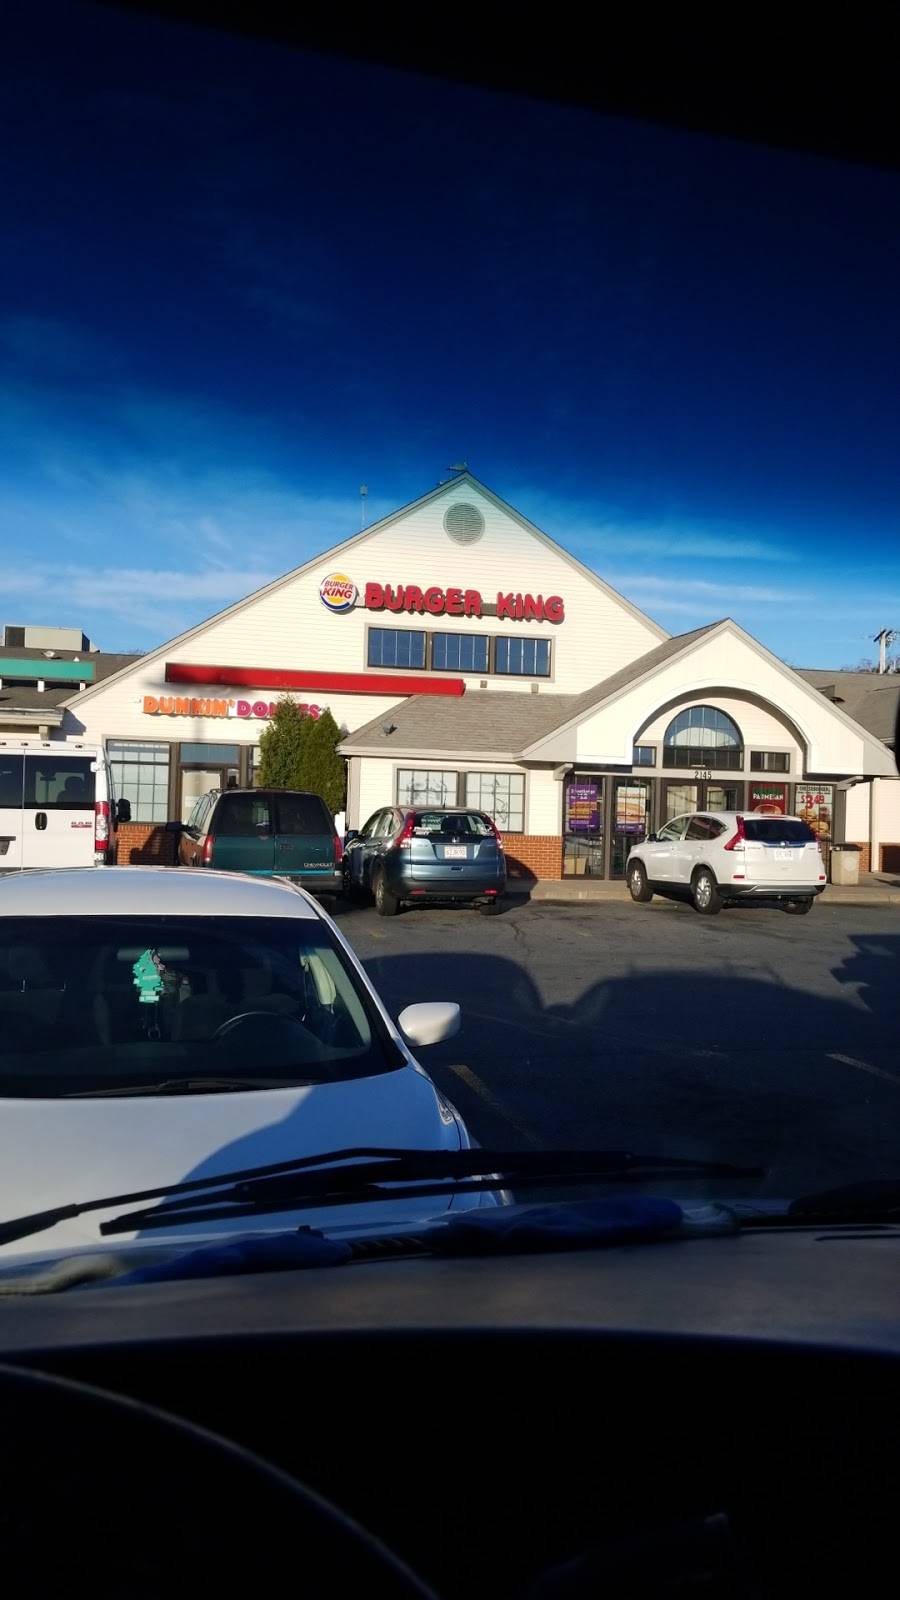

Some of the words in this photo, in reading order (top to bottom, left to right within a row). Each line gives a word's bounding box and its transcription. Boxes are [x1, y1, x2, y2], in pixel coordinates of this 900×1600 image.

[324, 580, 353, 590] BURGER
[323, 588, 353, 599] KING
[365, 582, 482, 616] BURGER
[496, 591, 564, 622] KING
[237, 700, 320, 721] DOTS
[694, 770, 711, 781] 2145
